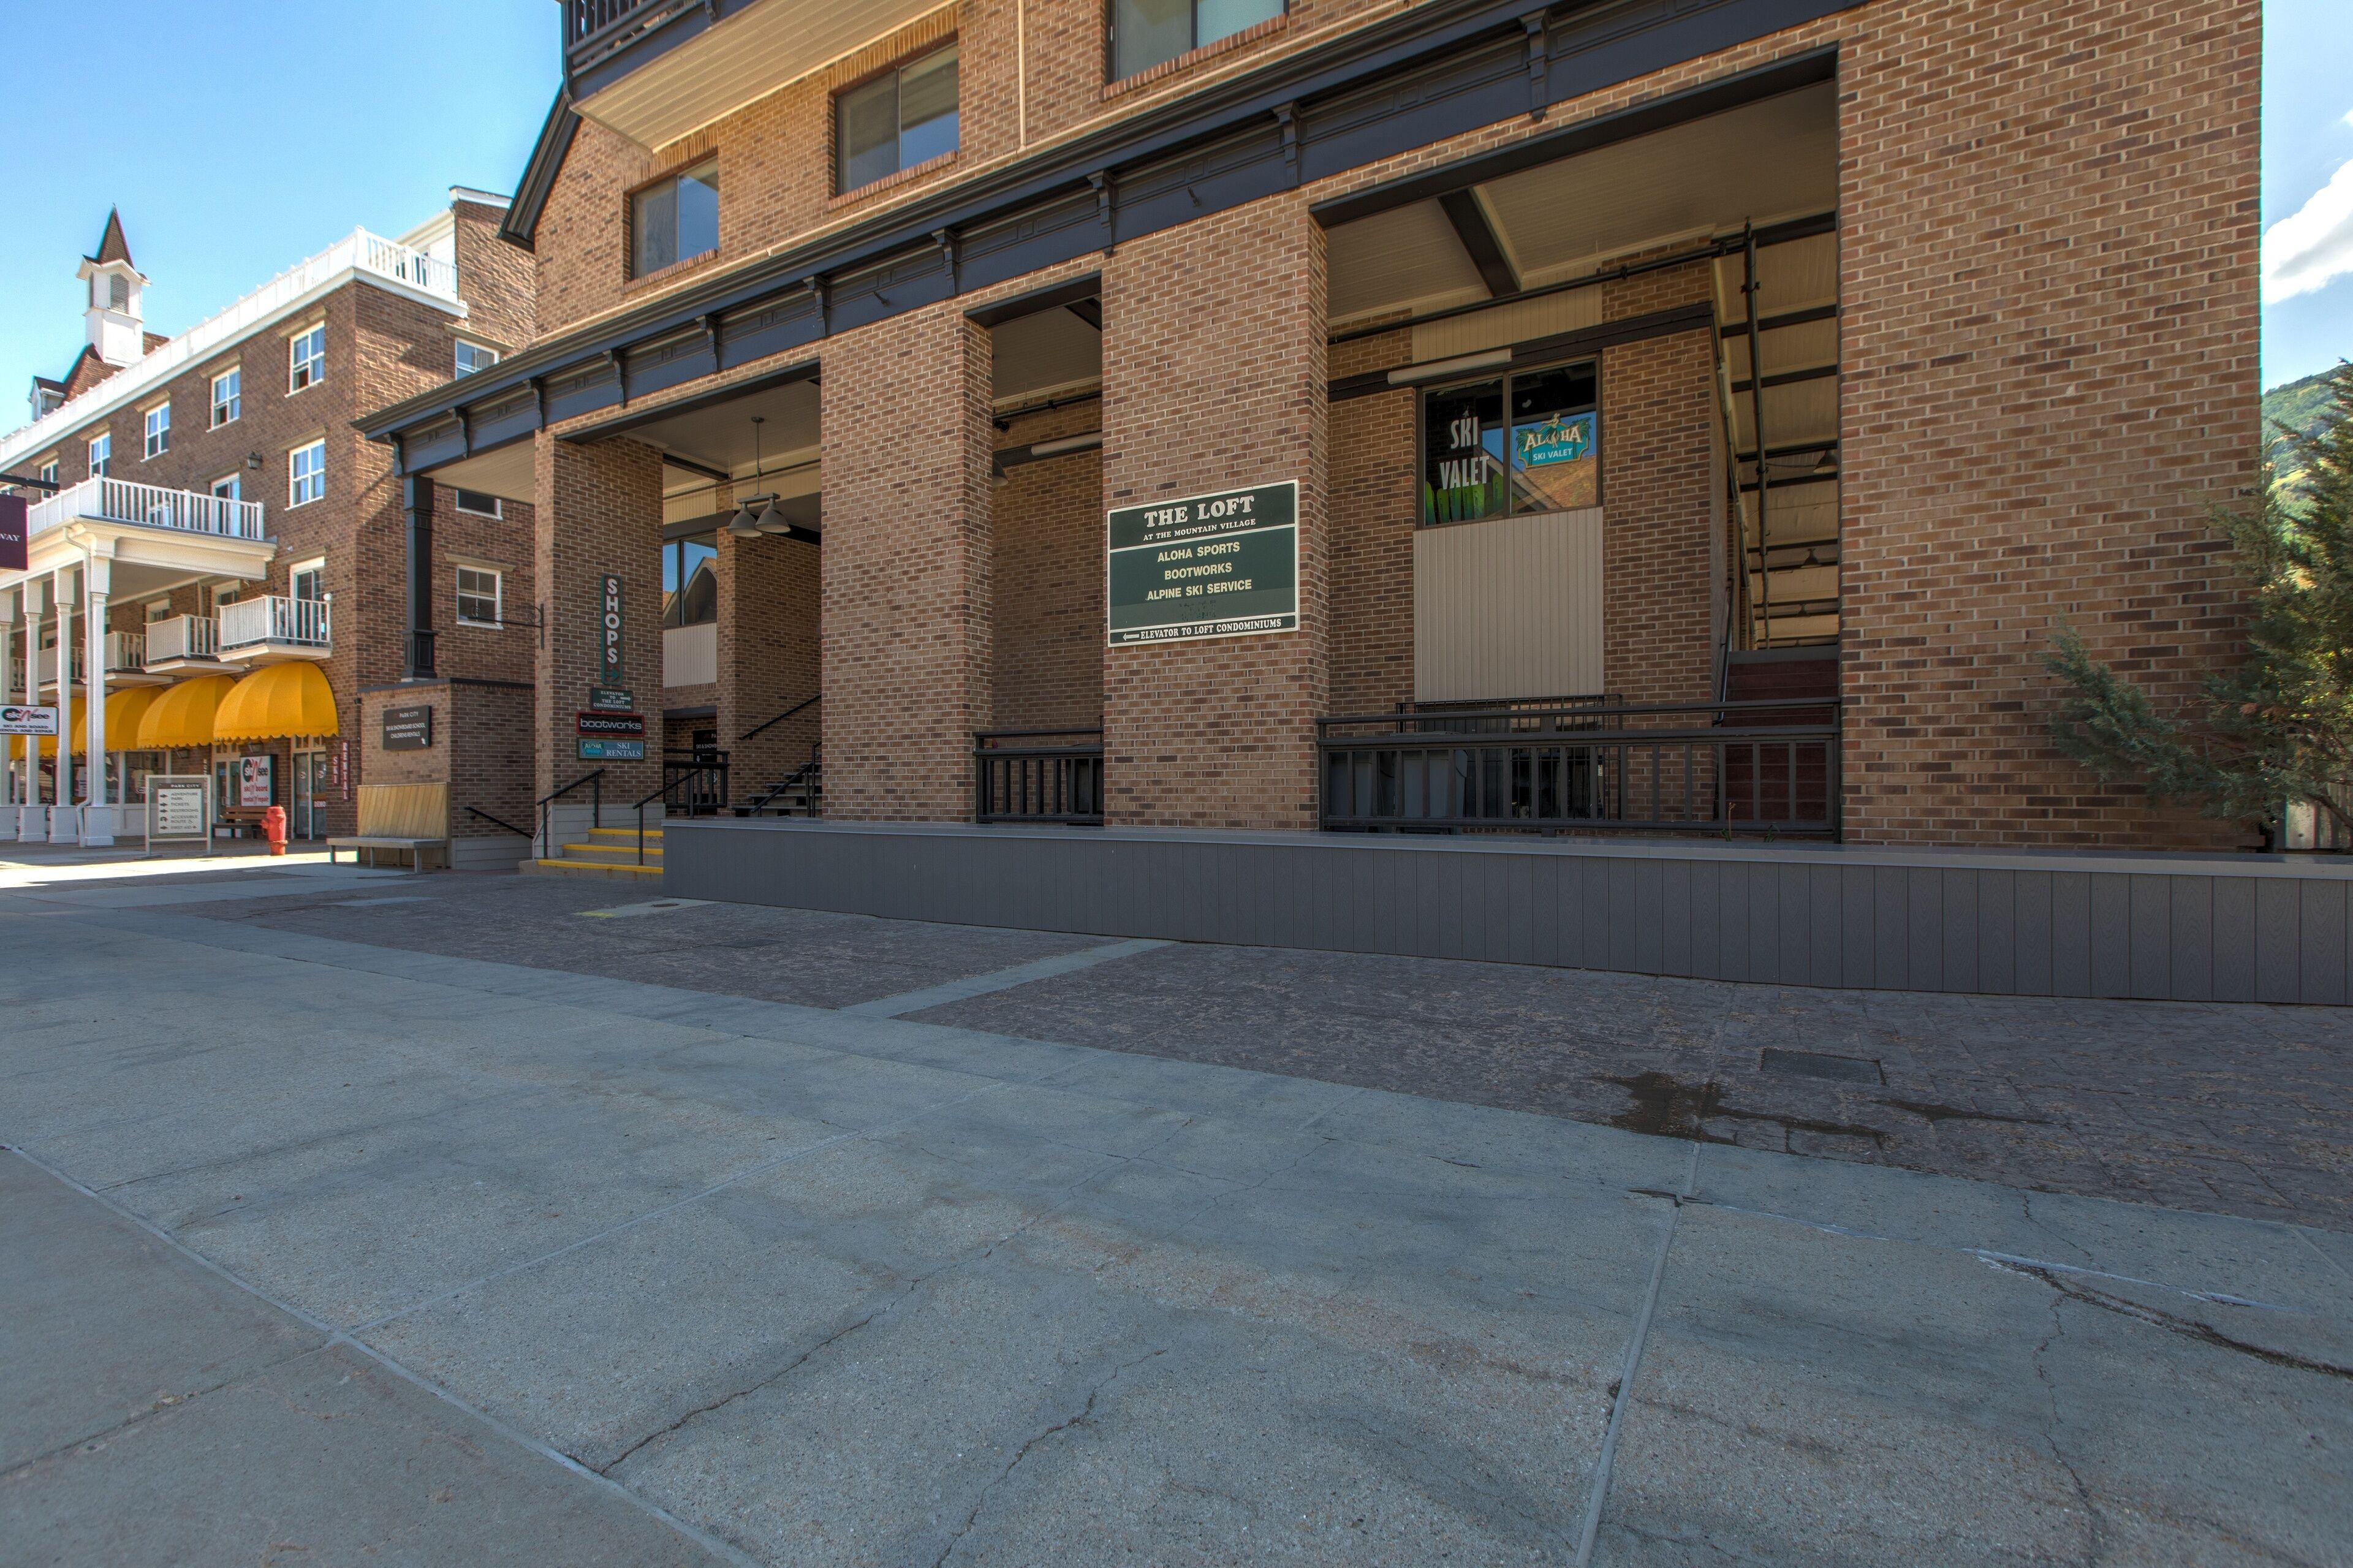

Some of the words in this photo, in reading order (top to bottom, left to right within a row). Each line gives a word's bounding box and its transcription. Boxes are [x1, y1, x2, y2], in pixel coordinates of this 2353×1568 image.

[1450, 416, 1478, 449] SKI
[1548, 448, 1573, 458] VALET
[1440, 455, 1490, 490] VALET
[1144, 506, 1188, 528] THE
[1197, 495, 1254, 520] LOFT
[1174, 524, 1218, 537] MOUNTAIN
[1220, 518, 1256, 529] VILLAGE
[1158, 548, 1192, 562] ALOHA
[1197, 542, 1240, 557] SPORTS
[1164, 562, 1232, 580] BOOTWORKS
[1147, 587, 1181, 601] ALPINE
[1186, 585, 1203, 596] SKI
[1207, 579, 1252, 594] SERVICE
[605, 578, 620, 664] SHOPS
[1140, 628, 1178, 640] ELEVATOR
[1181, 627, 1192, 635] TO
[1194, 624, 1214, 634] LOFT
[1216, 618, 1281, 632] CONDOMINIUMS
[580, 718, 642, 730] bootworks
